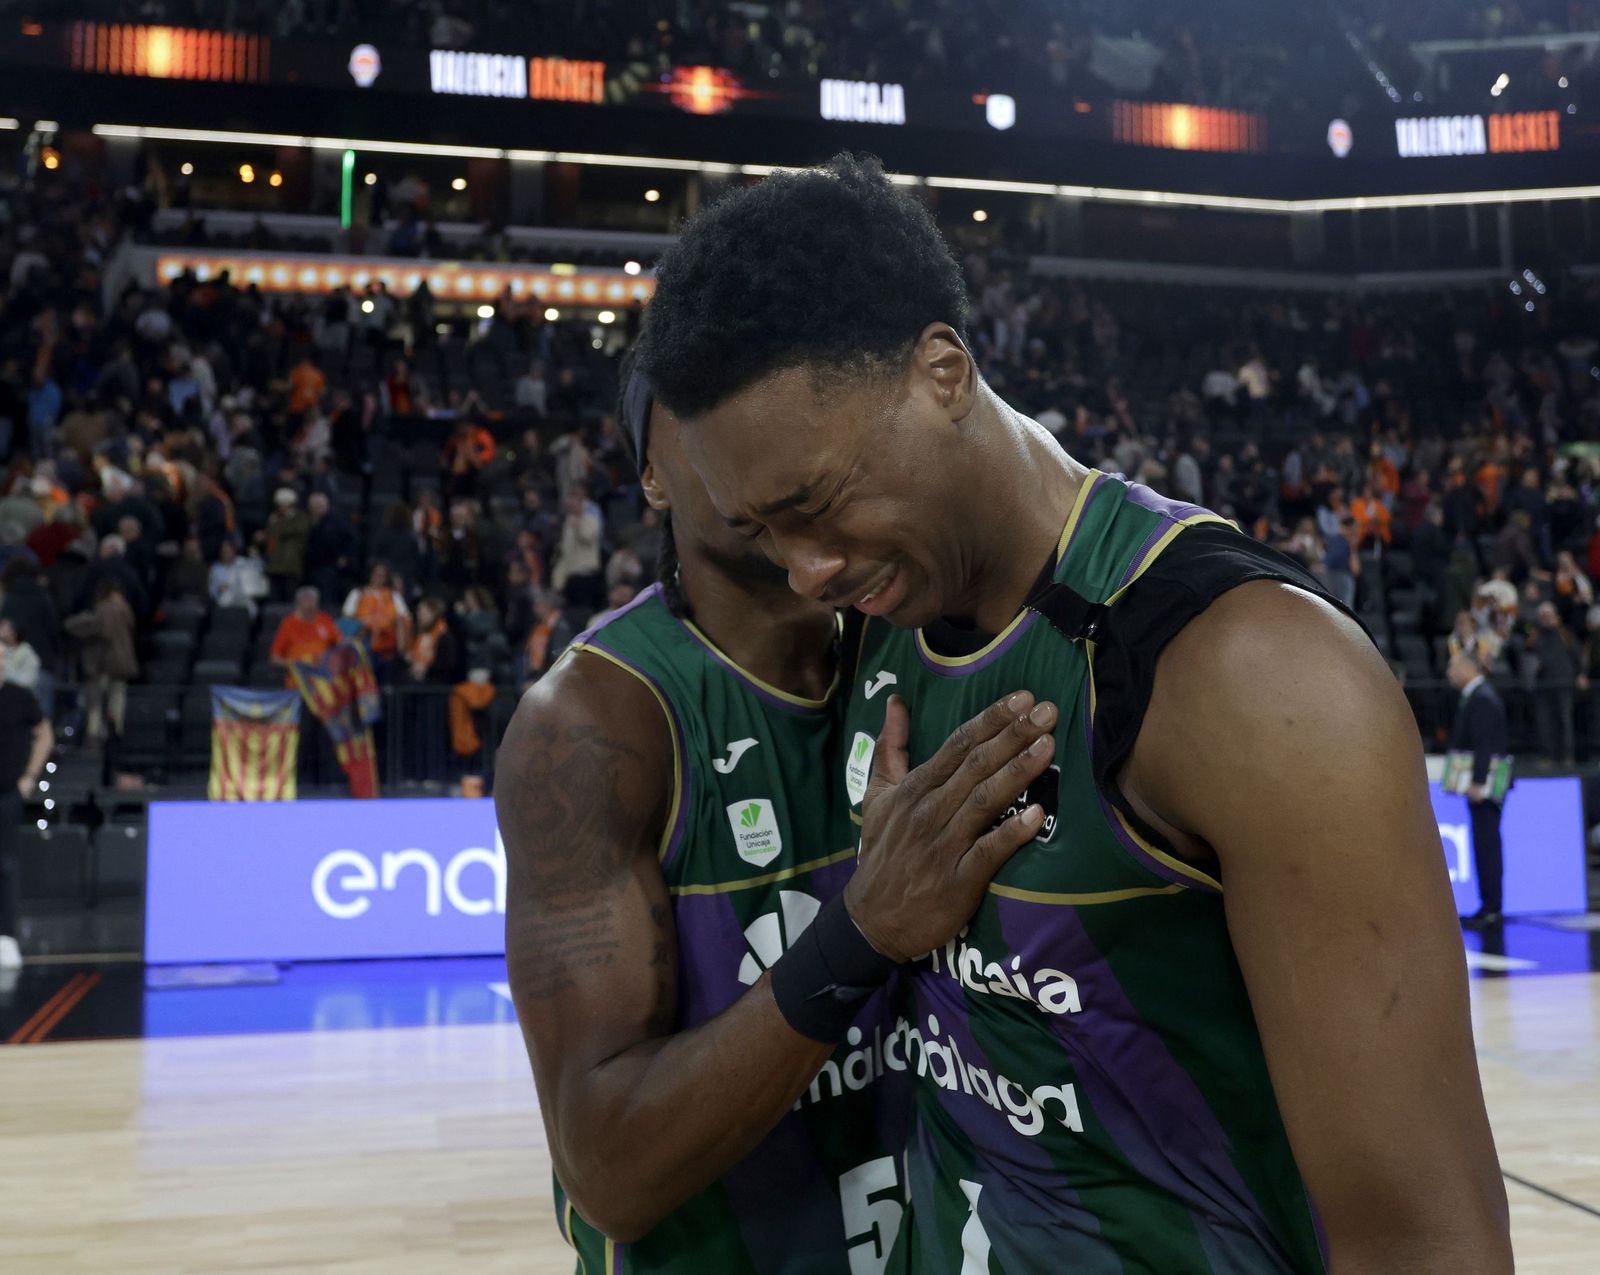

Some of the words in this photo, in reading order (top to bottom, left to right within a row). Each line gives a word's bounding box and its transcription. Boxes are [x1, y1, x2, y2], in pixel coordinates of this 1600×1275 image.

[429, 50, 527, 99] VALENCIA
[529, 57, 606, 104] BASKET
[820, 78, 906, 125] UNICAJA
[1395, 114, 1487, 158] VALENCIA
[1488, 110, 1560, 154] BASKET
[746, 839, 771, 849] Unicaja
[311, 826, 508, 919] end
[911, 925, 1083, 1015] nicaja
